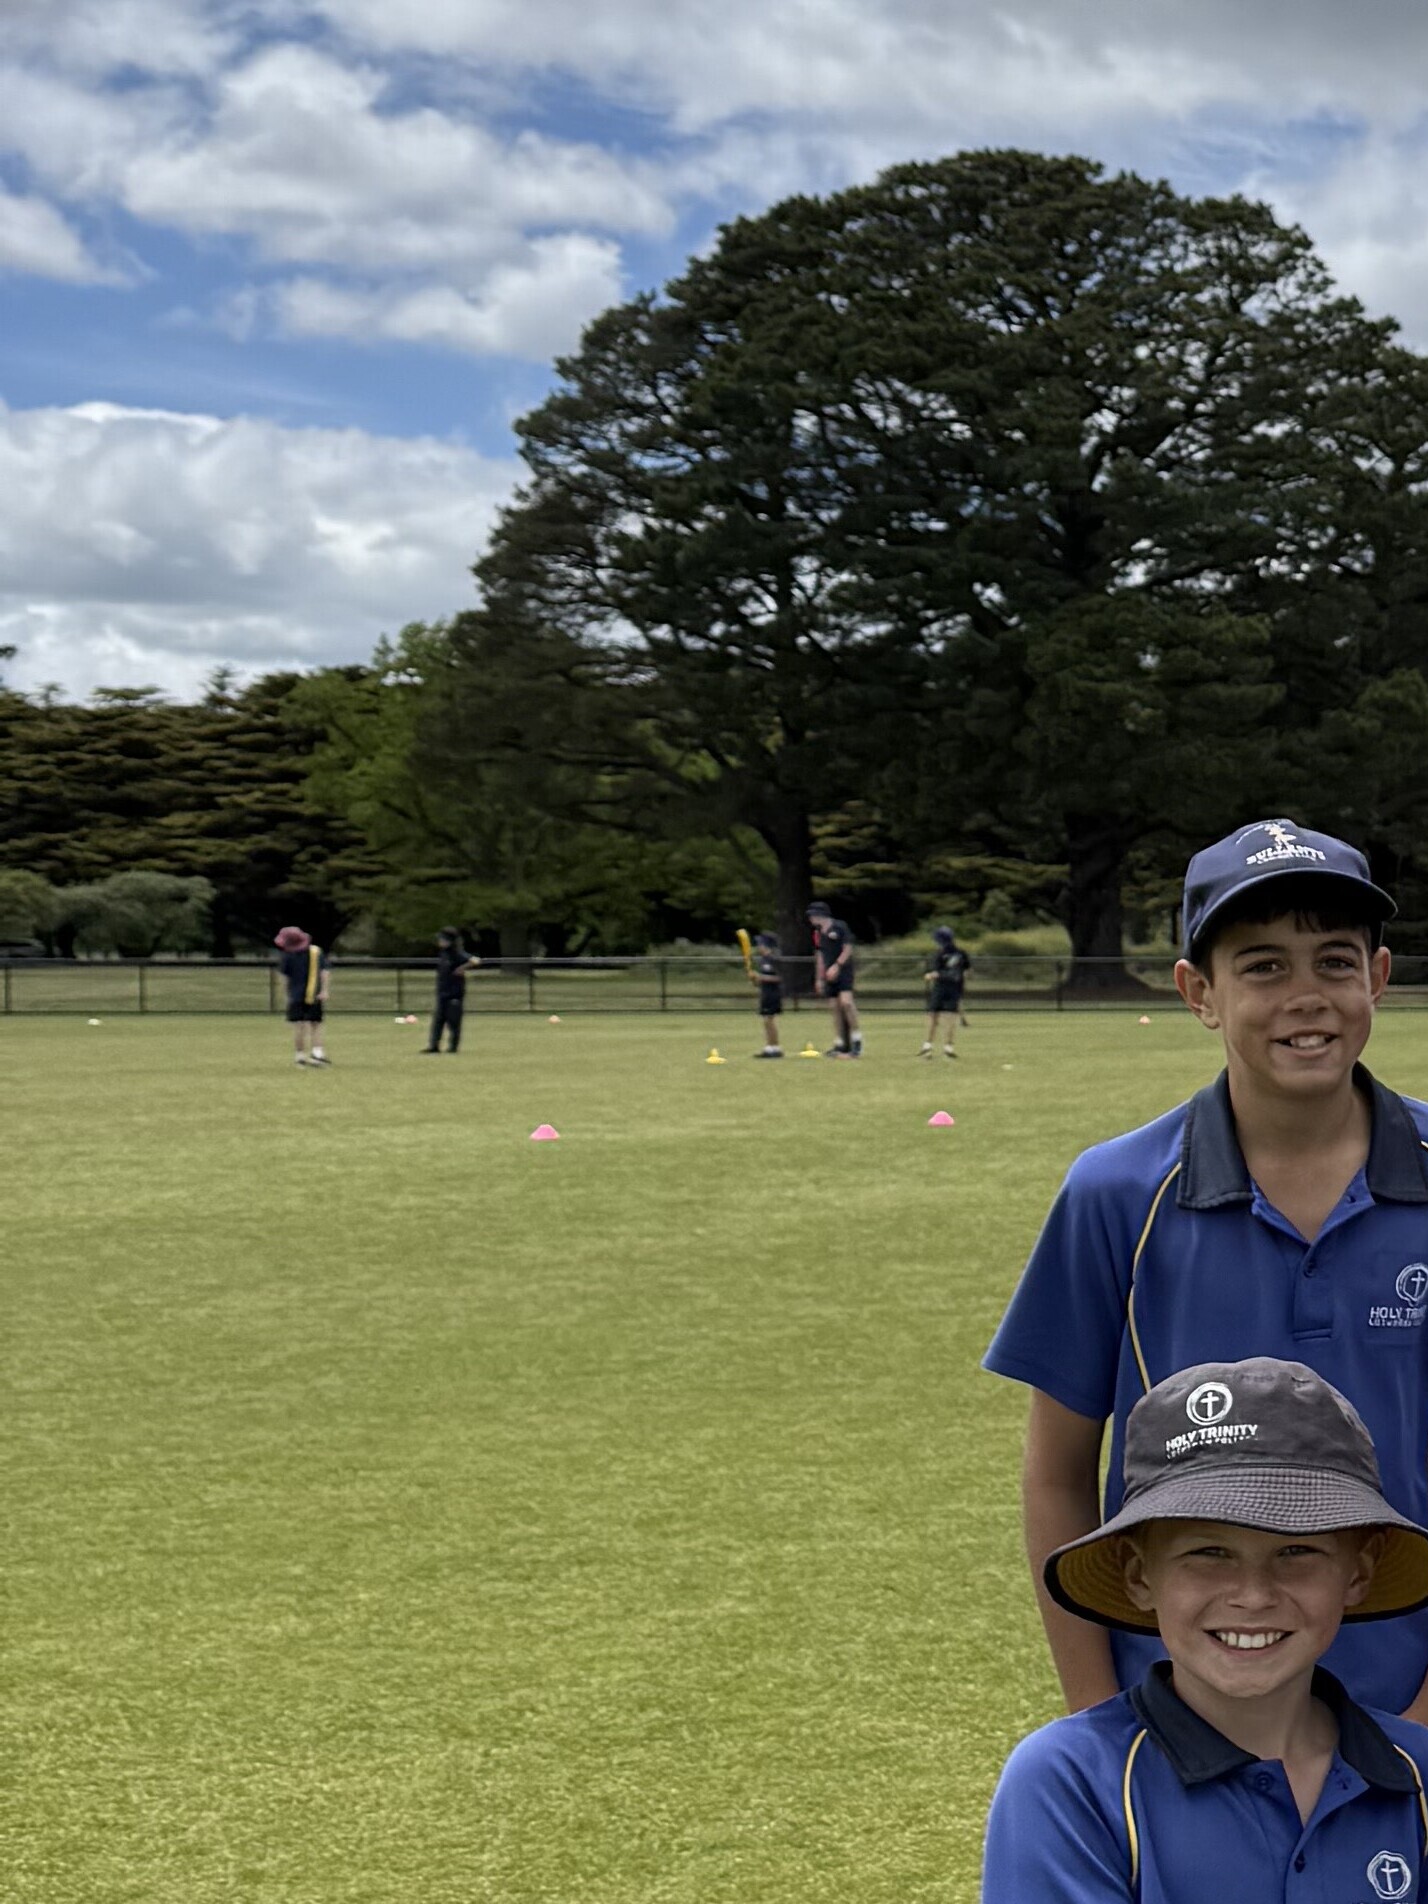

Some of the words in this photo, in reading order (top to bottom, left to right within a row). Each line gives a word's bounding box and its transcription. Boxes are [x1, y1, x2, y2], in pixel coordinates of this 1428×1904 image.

[1370, 1307, 1403, 1319] HOLY
[1166, 1430, 1197, 1452] HOLY
[1199, 1424, 1258, 1440] TRINITY
